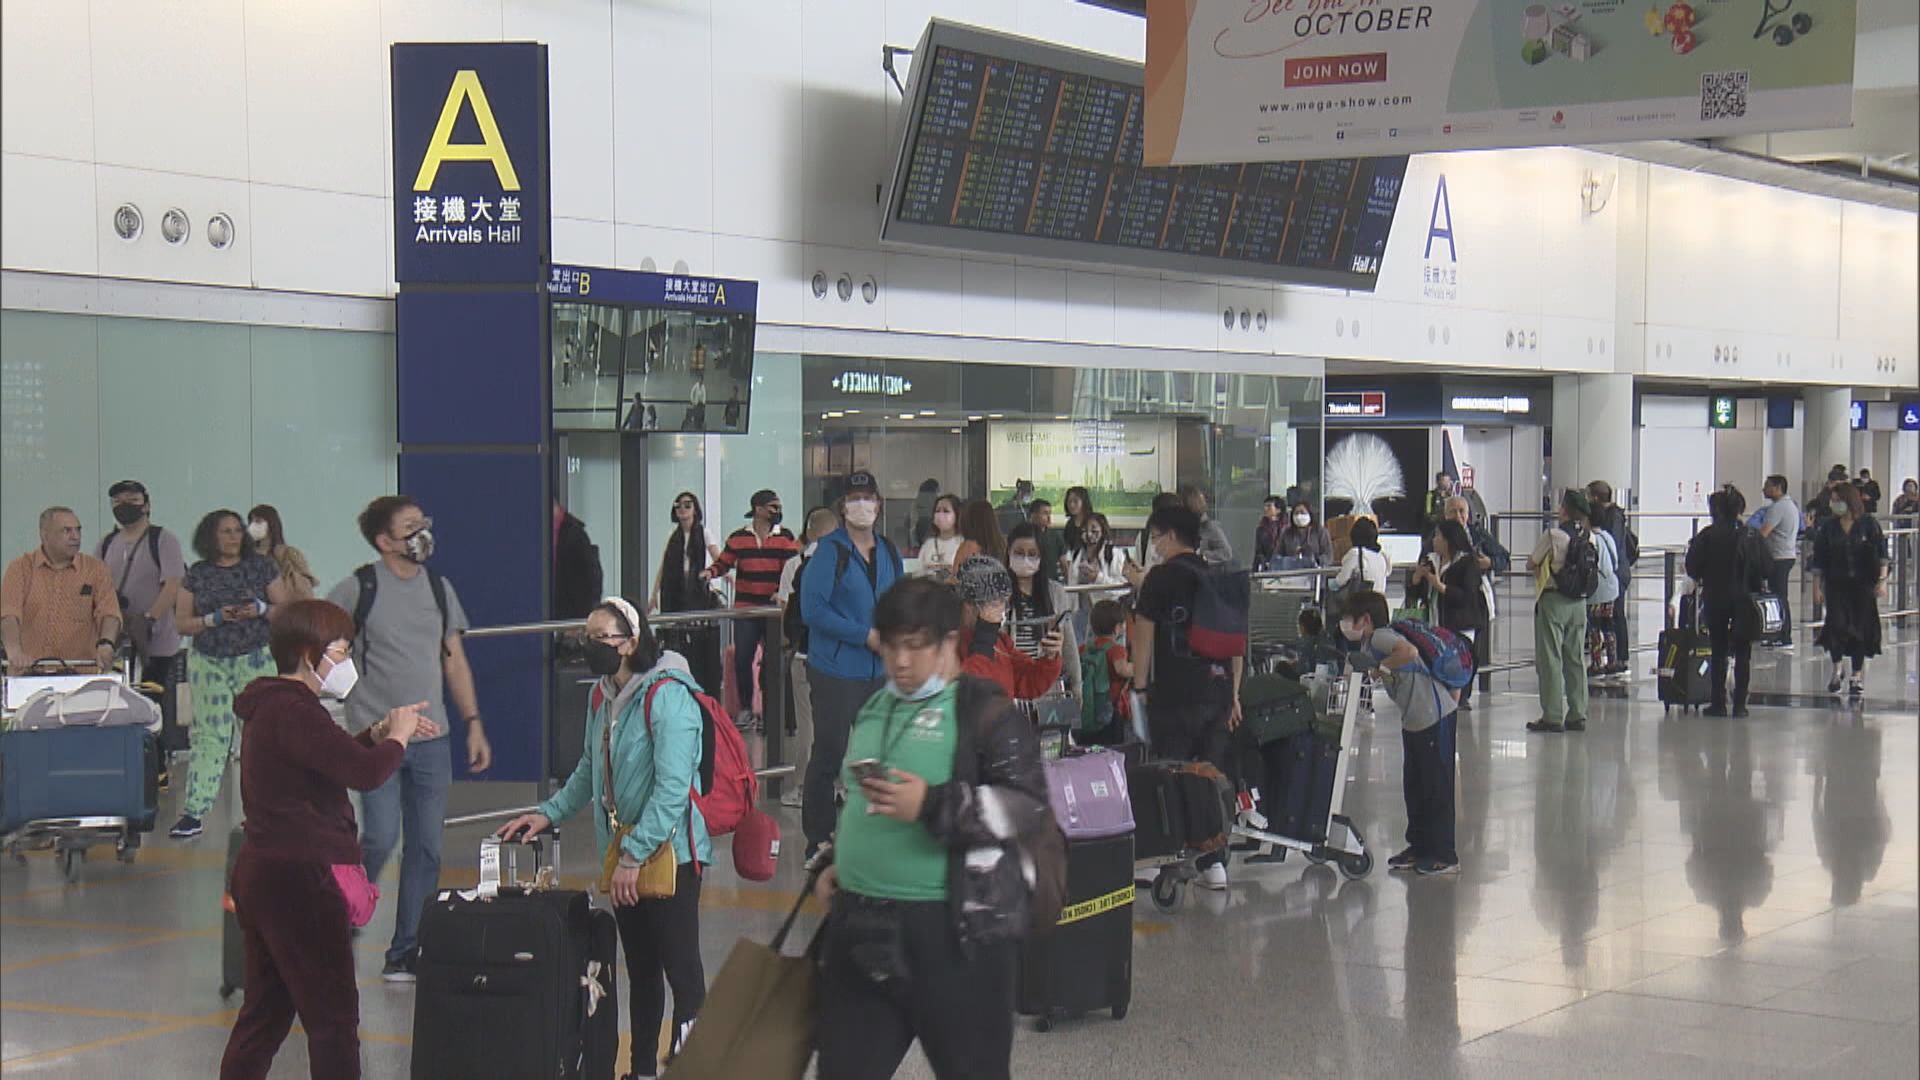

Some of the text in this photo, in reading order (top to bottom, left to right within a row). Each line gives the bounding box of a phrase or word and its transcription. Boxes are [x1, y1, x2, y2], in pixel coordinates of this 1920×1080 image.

[1294, 6, 1433, 37] OCTOBER
[1292, 60, 1378, 80] JOIN NOW
[1259, 94, 1412, 113] www.mega-show.com
[412, 70, 521, 191] A
[413, 196, 521, 223] 接機大堂
[1424, 173, 1457, 263] A
[415, 224, 520, 243] Arrivals Hall
[560, 283, 571, 293] Exit
[579, 272, 591, 295] B
[714, 284, 726, 305] A
